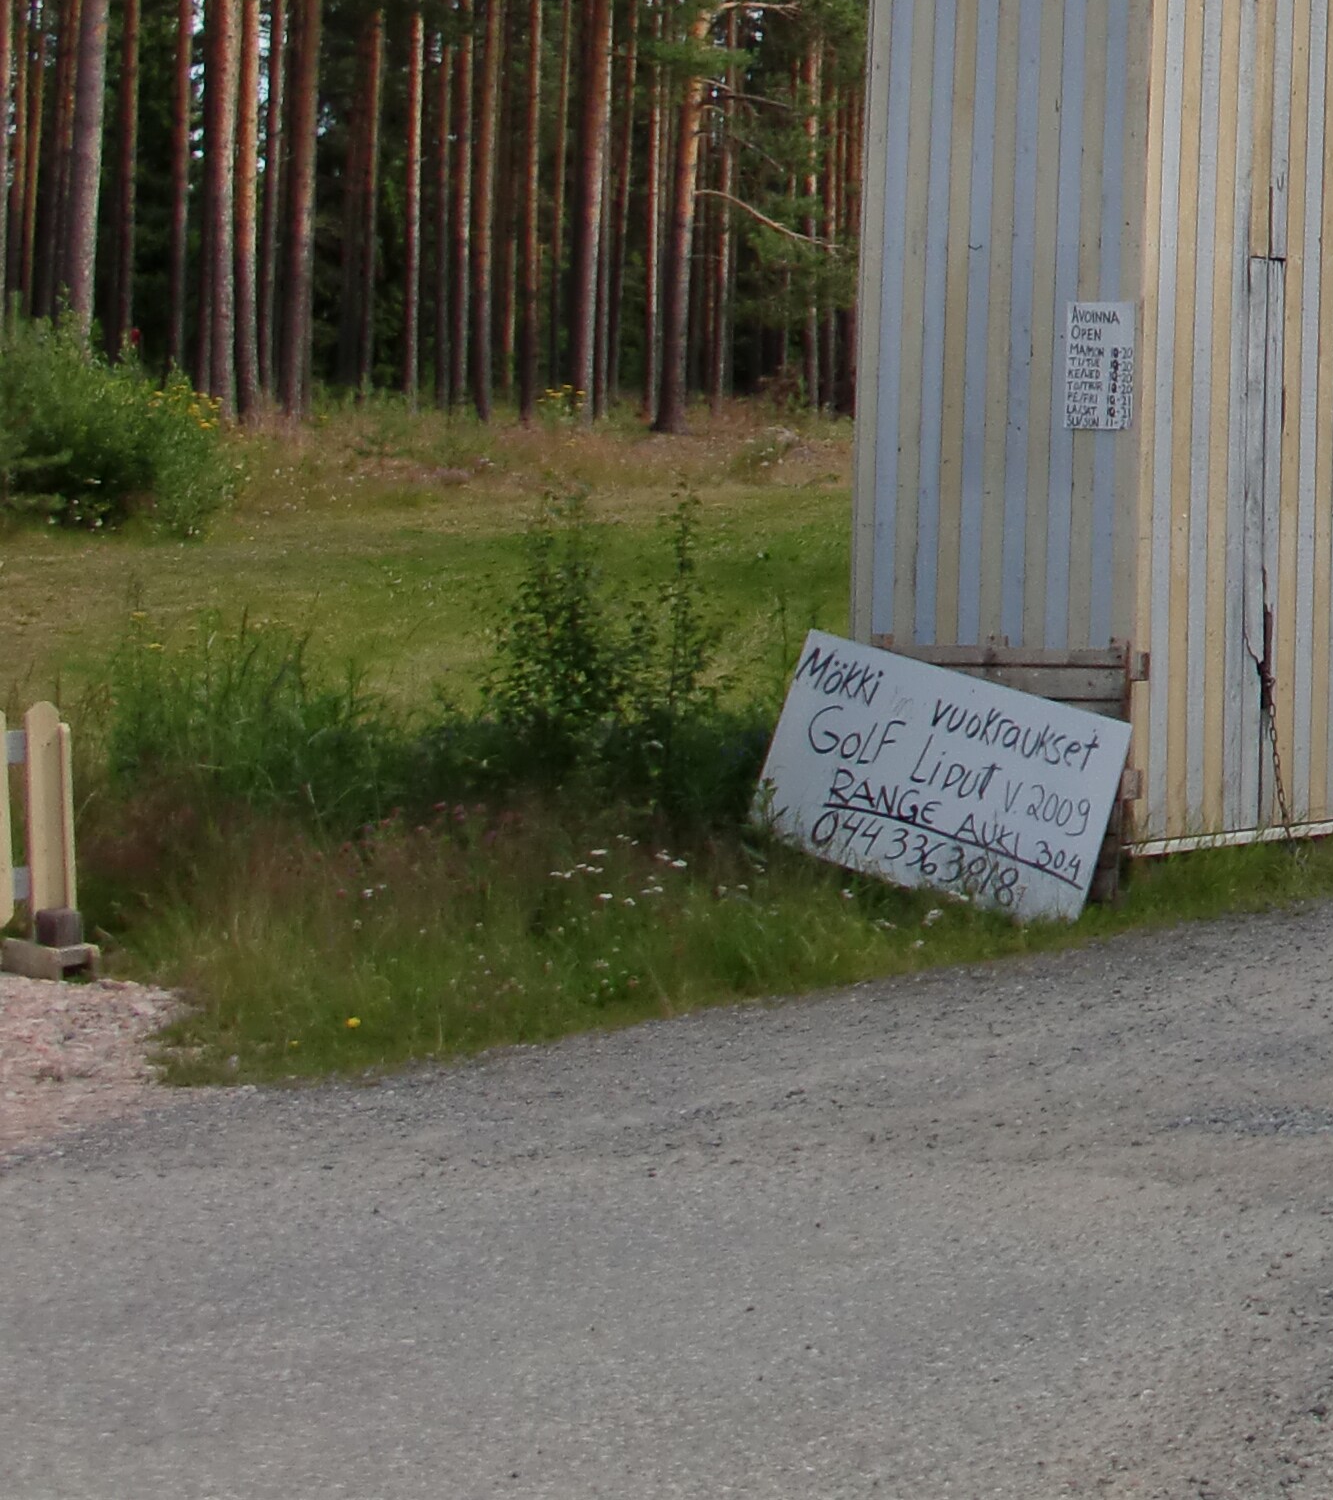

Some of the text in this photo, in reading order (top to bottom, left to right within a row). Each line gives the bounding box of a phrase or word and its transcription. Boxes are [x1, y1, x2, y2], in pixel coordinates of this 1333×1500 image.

[1070, 325, 1102, 341] OPEN
[1071, 306, 1121, 325] AVOINNA
[829, 768, 942, 825] RANGE
[1027, 784, 1091, 836] 2009
